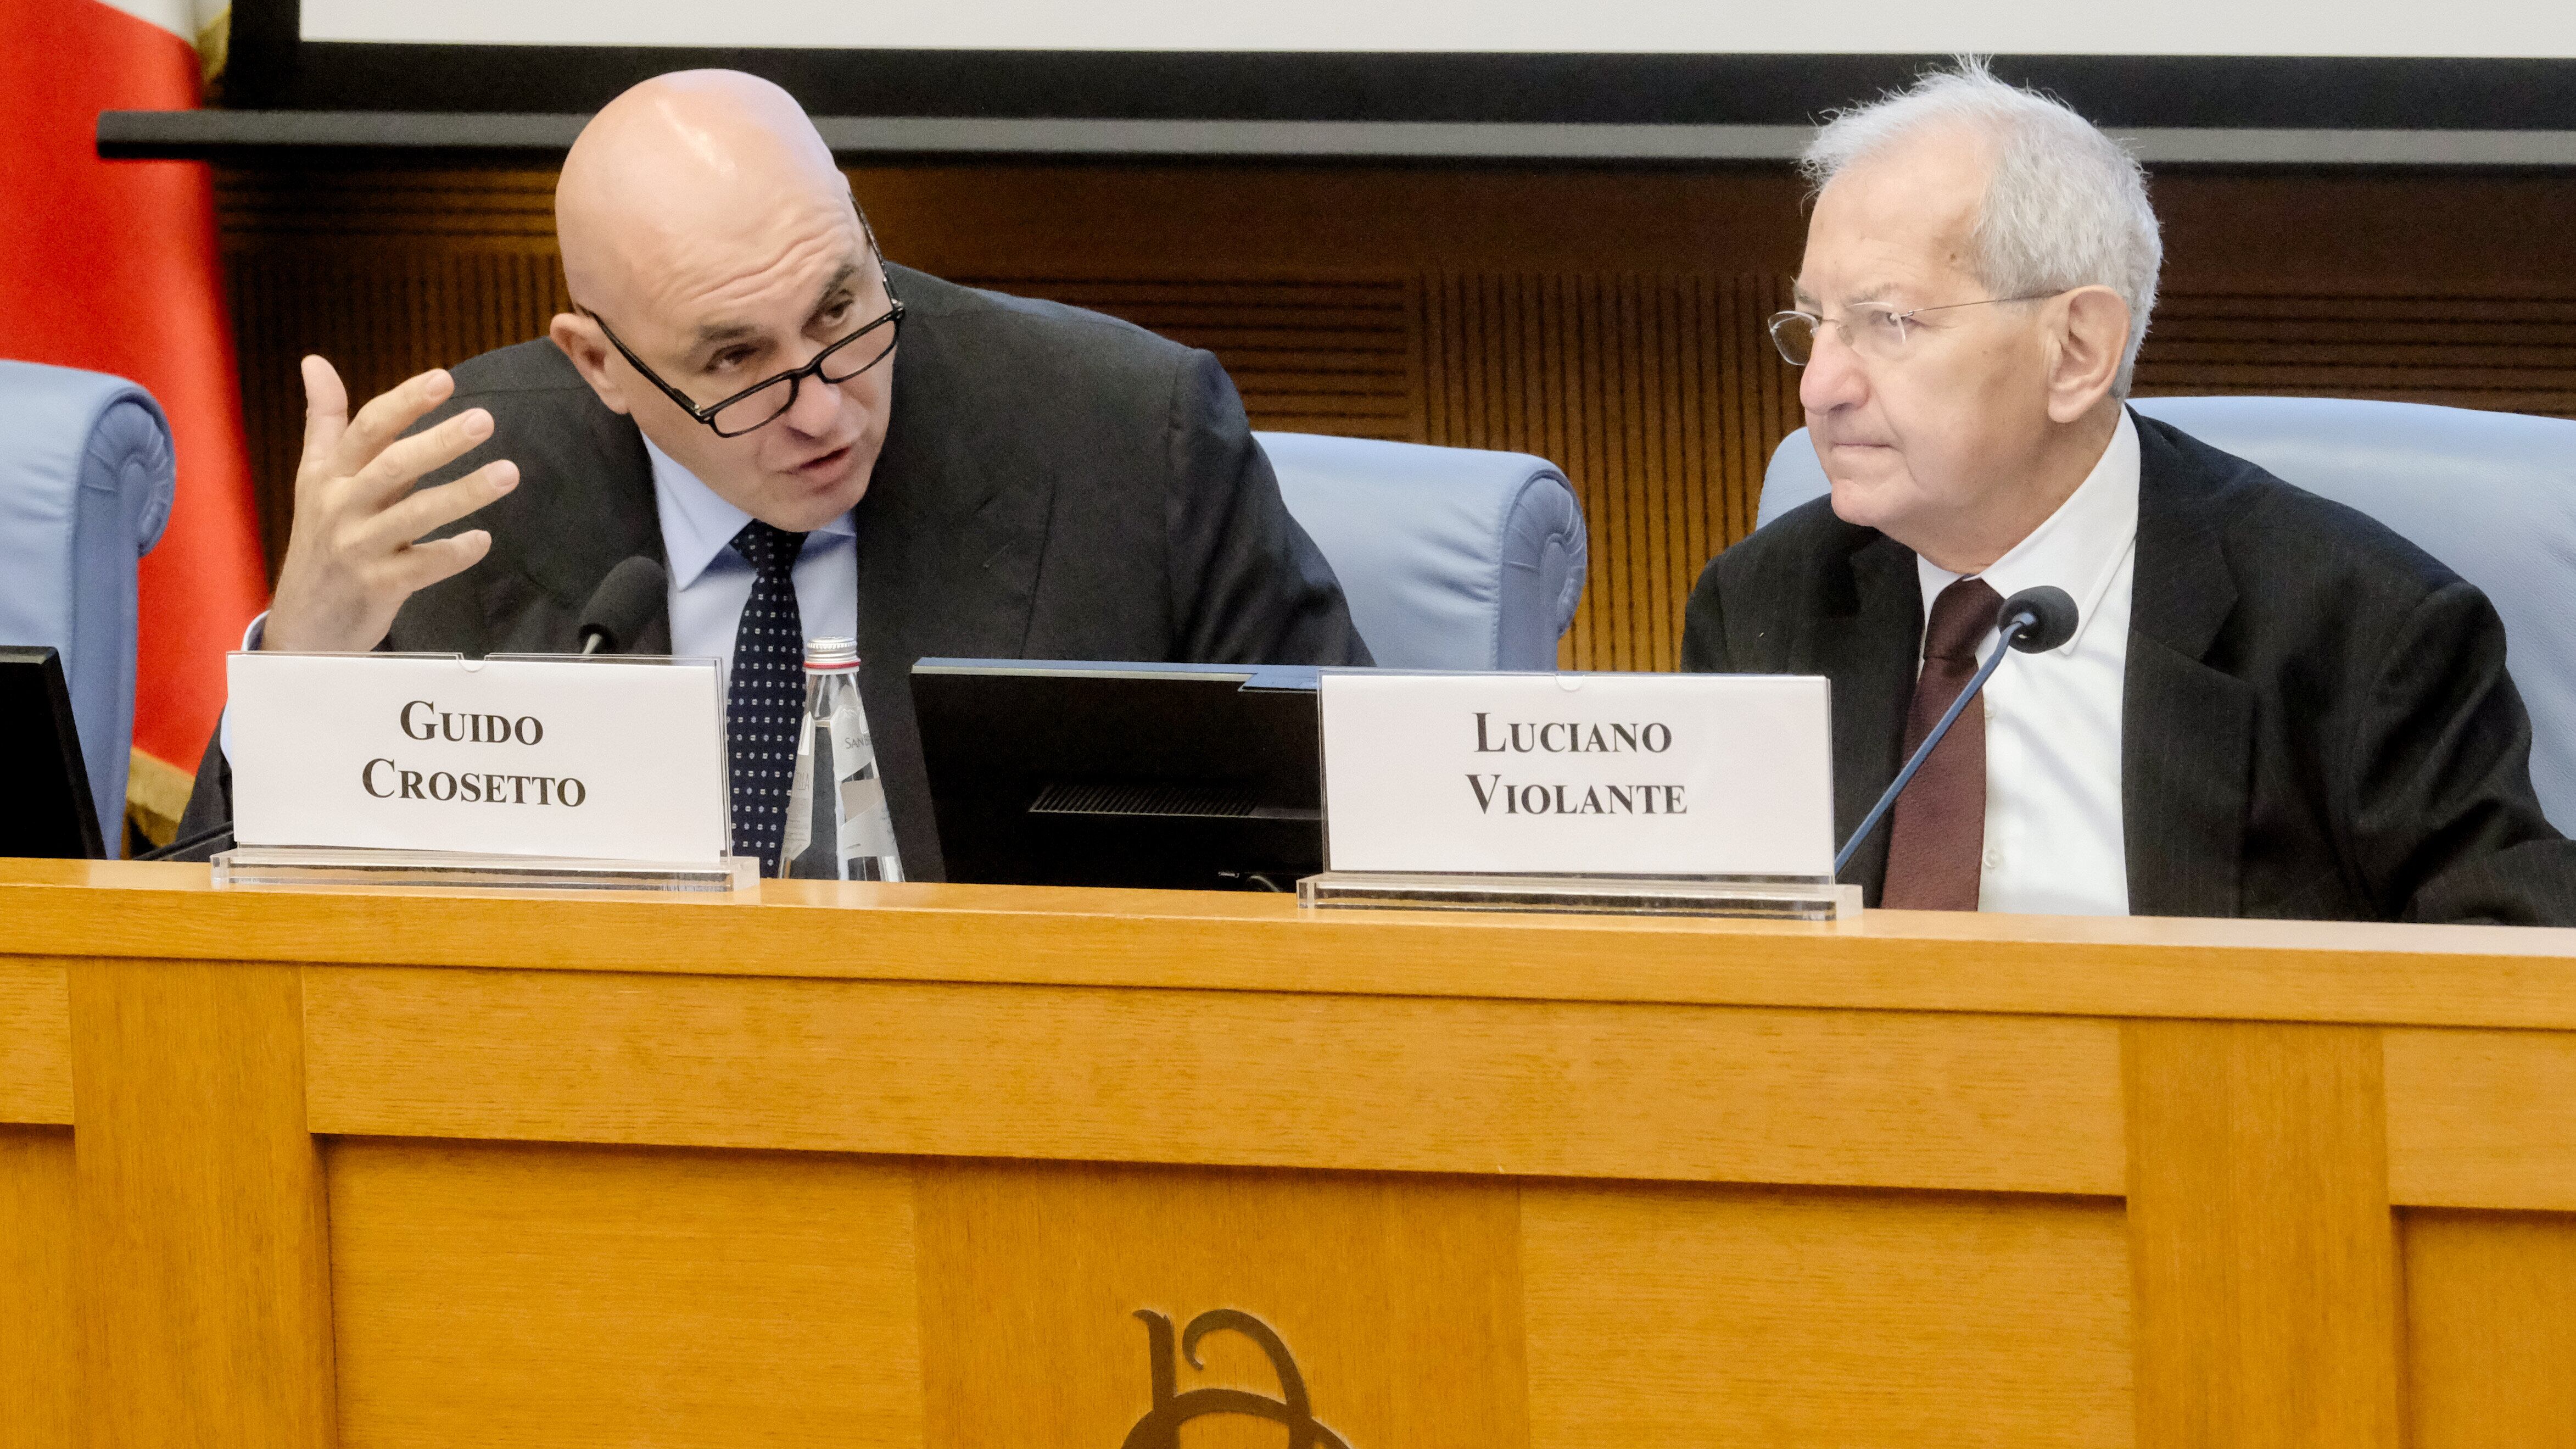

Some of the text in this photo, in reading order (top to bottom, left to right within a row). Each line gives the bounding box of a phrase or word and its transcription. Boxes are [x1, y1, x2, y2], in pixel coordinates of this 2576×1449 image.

[400, 700, 544, 745] GUIDO
[1473, 712, 1672, 753] LUCIANO
[362, 758, 586, 807] CROSETTO
[1465, 774, 1688, 815] VIOLANTE
